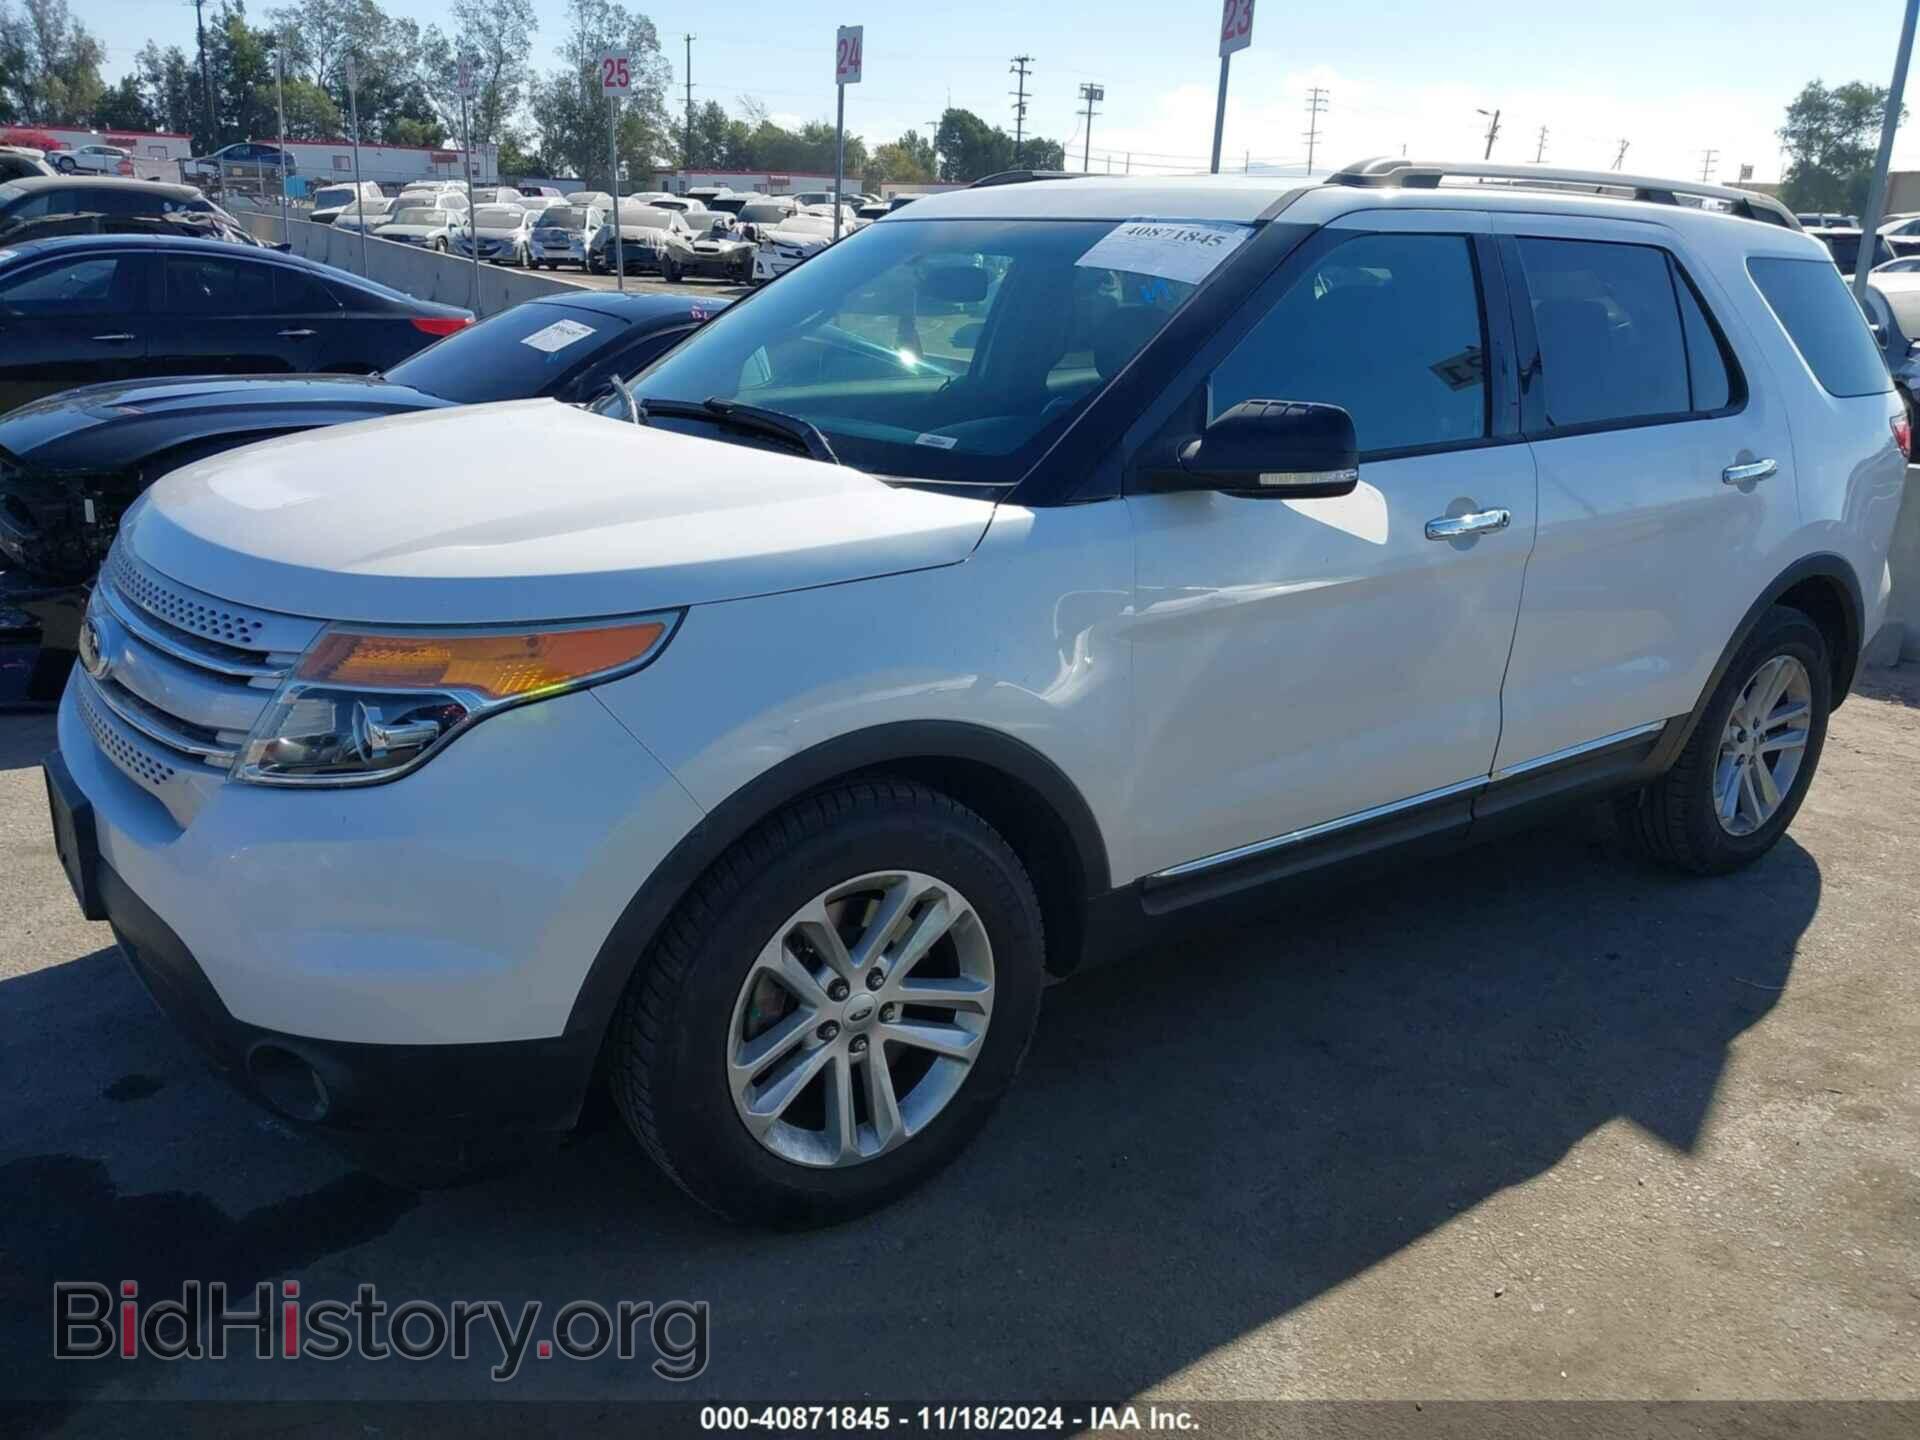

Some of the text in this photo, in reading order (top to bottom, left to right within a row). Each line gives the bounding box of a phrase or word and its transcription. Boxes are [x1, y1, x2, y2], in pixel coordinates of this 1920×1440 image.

[1223, 0, 1250, 40] 23
[838, 37, 860, 74] 24
[603, 58, 629, 87] 25
[1126, 225, 1227, 247] 40871845
